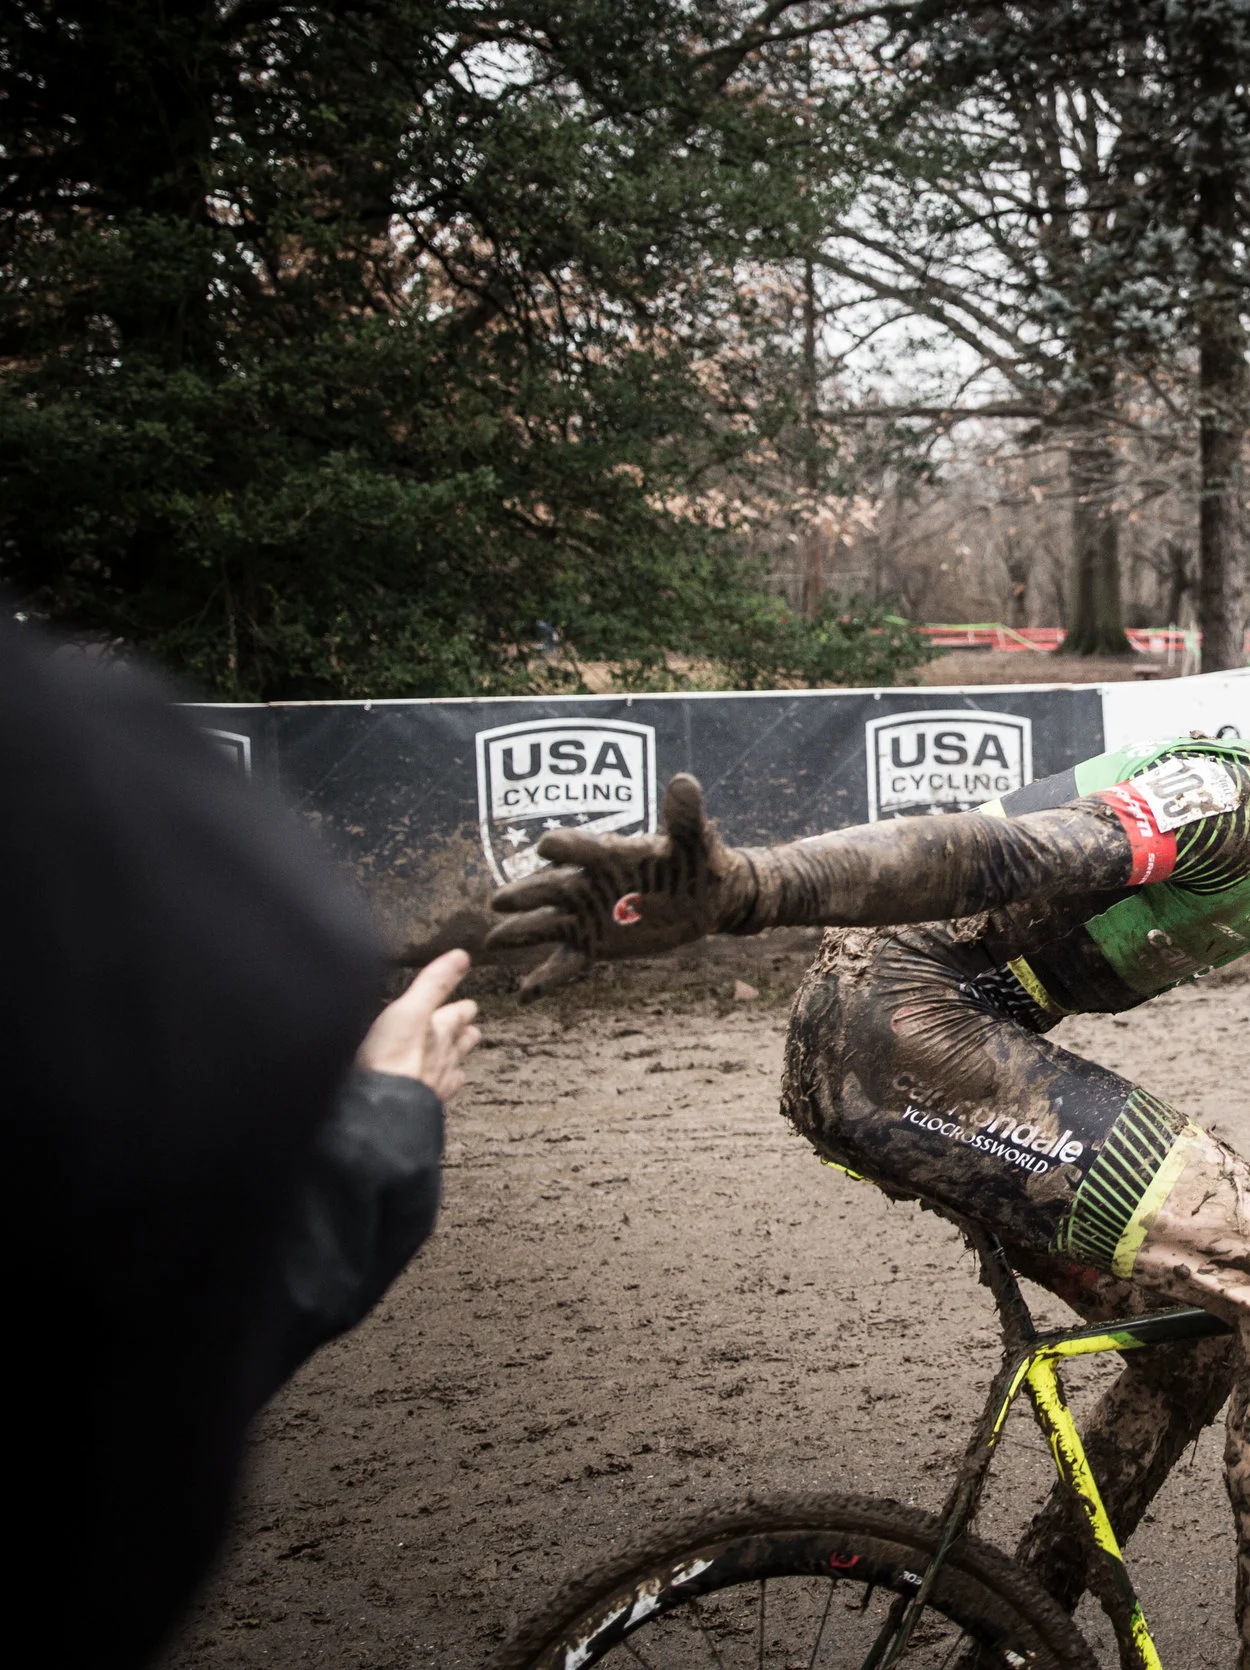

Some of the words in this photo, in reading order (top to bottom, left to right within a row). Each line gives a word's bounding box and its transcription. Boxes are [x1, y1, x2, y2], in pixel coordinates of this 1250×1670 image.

[502, 740, 632, 780] USA
[891, 731, 1010, 769] USA
[504, 783, 632, 806] CYCLING
[892, 773, 1010, 793] CYCLING
